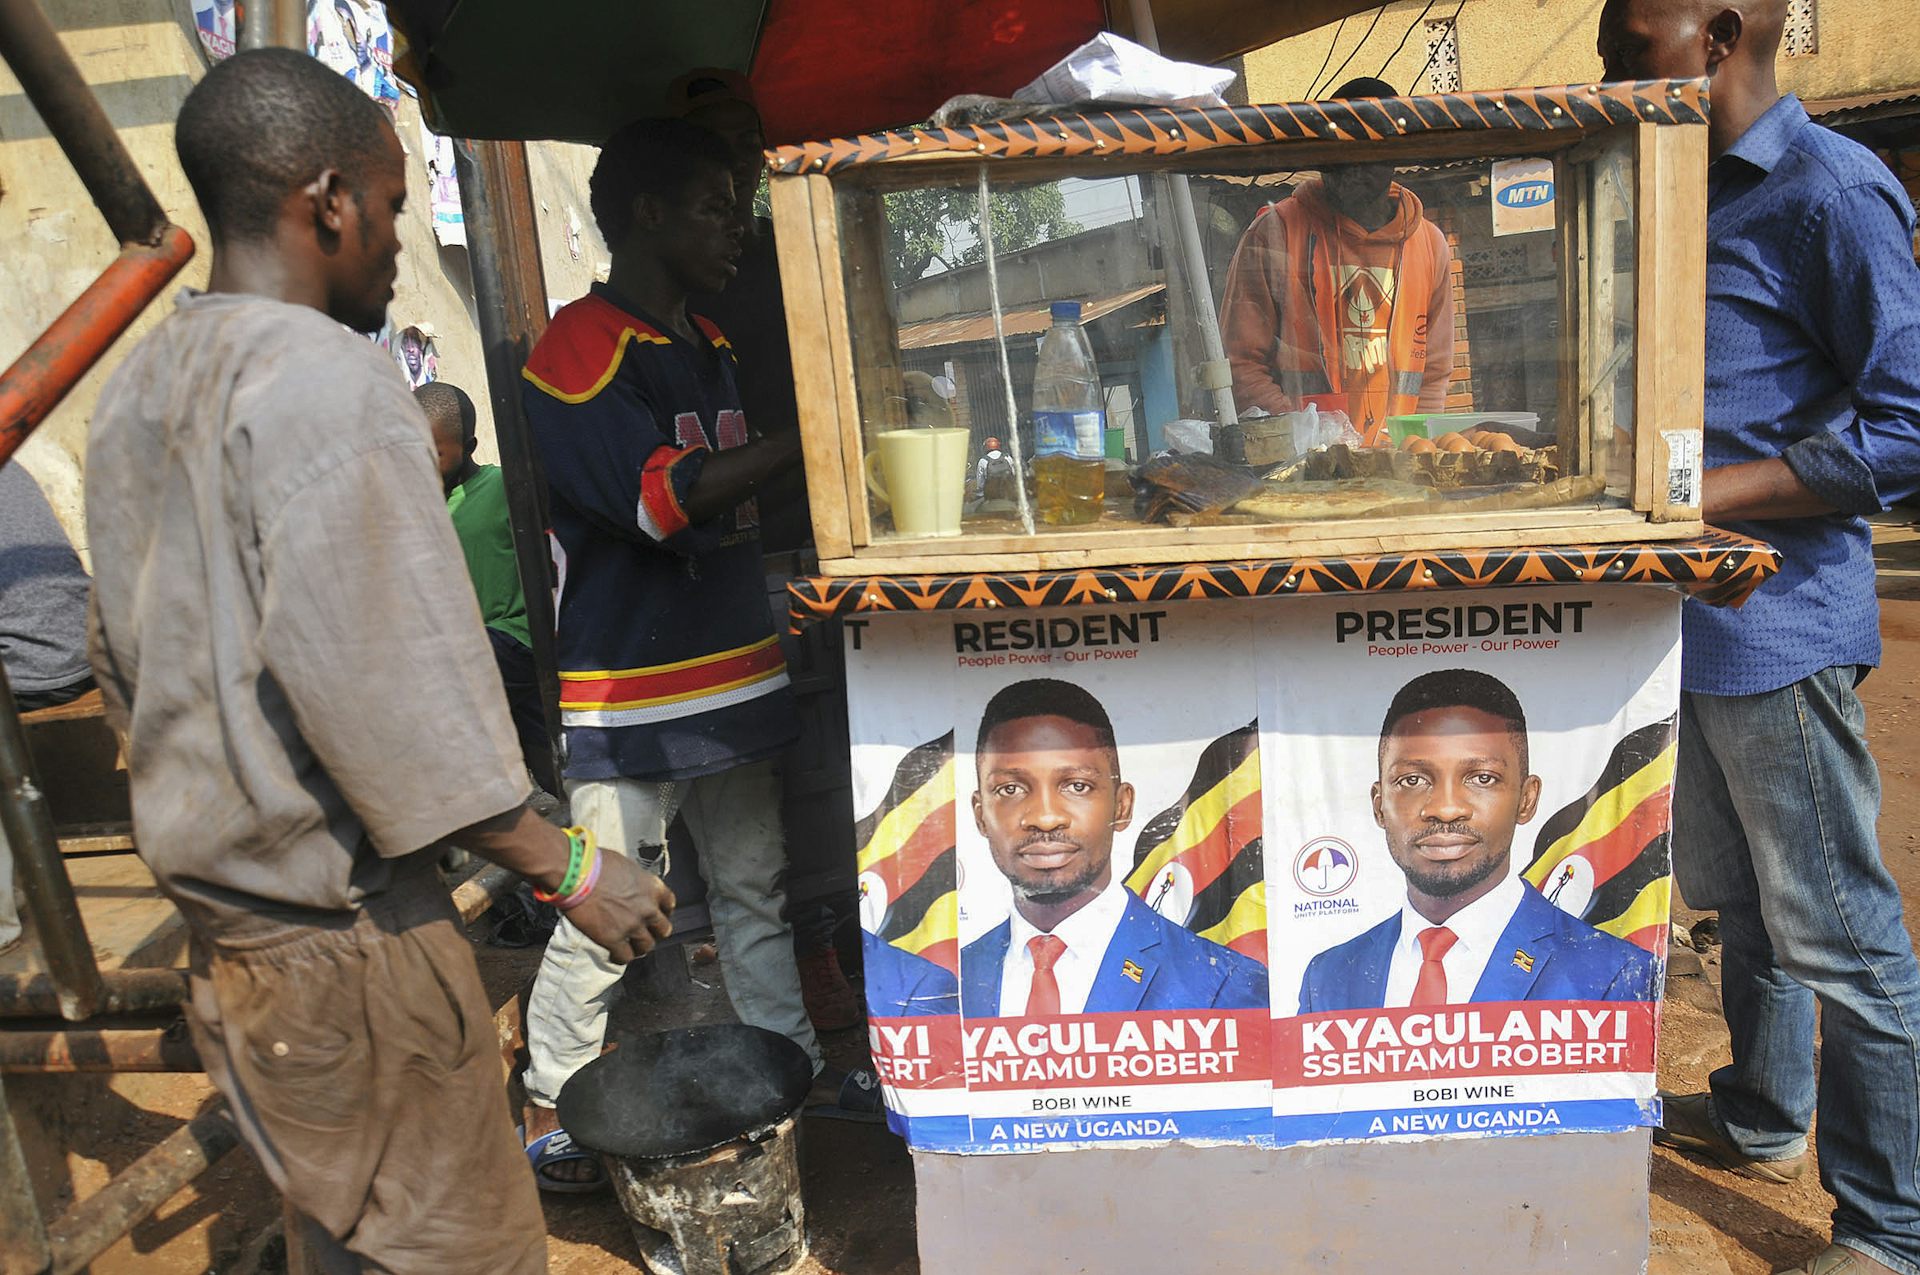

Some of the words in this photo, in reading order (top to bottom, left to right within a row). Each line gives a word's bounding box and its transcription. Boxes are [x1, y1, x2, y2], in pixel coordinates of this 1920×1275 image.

[1507, 184, 1549, 204] MTN
[954, 611, 1166, 653] RESIDENT
[1336, 601, 1592, 643] PRESIDENT
[844, 620, 869, 650] T
[958, 654, 1005, 668] People
[1008, 651, 1052, 666] Power
[1064, 649, 1091, 662] Our
[1094, 647, 1139, 661] Power
[1368, 644, 1418, 658] People
[1422, 641, 1469, 655] Power
[1480, 638, 1509, 652] Our
[1512, 637, 1560, 651] Power
[1294, 898, 1359, 913] NATIONAL
[1294, 911, 1317, 919] UNITY
[1319, 908, 1360, 916] PLATFORM
[962, 1018, 1239, 1058] YAGULANYI
[1301, 1010, 1629, 1054] KYAGULANYI
[968, 1057, 1097, 1084] ENTAMU
[1107, 1051, 1240, 1079] ROBERT
[1302, 1046, 1480, 1079] SSENTAMU
[1491, 1041, 1628, 1069] ROBERT
[1032, 1097, 1076, 1111] BOBI
[1082, 1095, 1132, 1109] WINE
[1413, 1088, 1458, 1102] BOBI
[1464, 1085, 1515, 1099] WINE
[990, 1124, 1007, 1140] A
[1014, 1122, 1069, 1140] NEW
[1076, 1118, 1180, 1138] UGANDA
[1368, 1115, 1387, 1134] A
[1392, 1112, 1450, 1132] NEW
[1456, 1108, 1561, 1129] UGANDA
